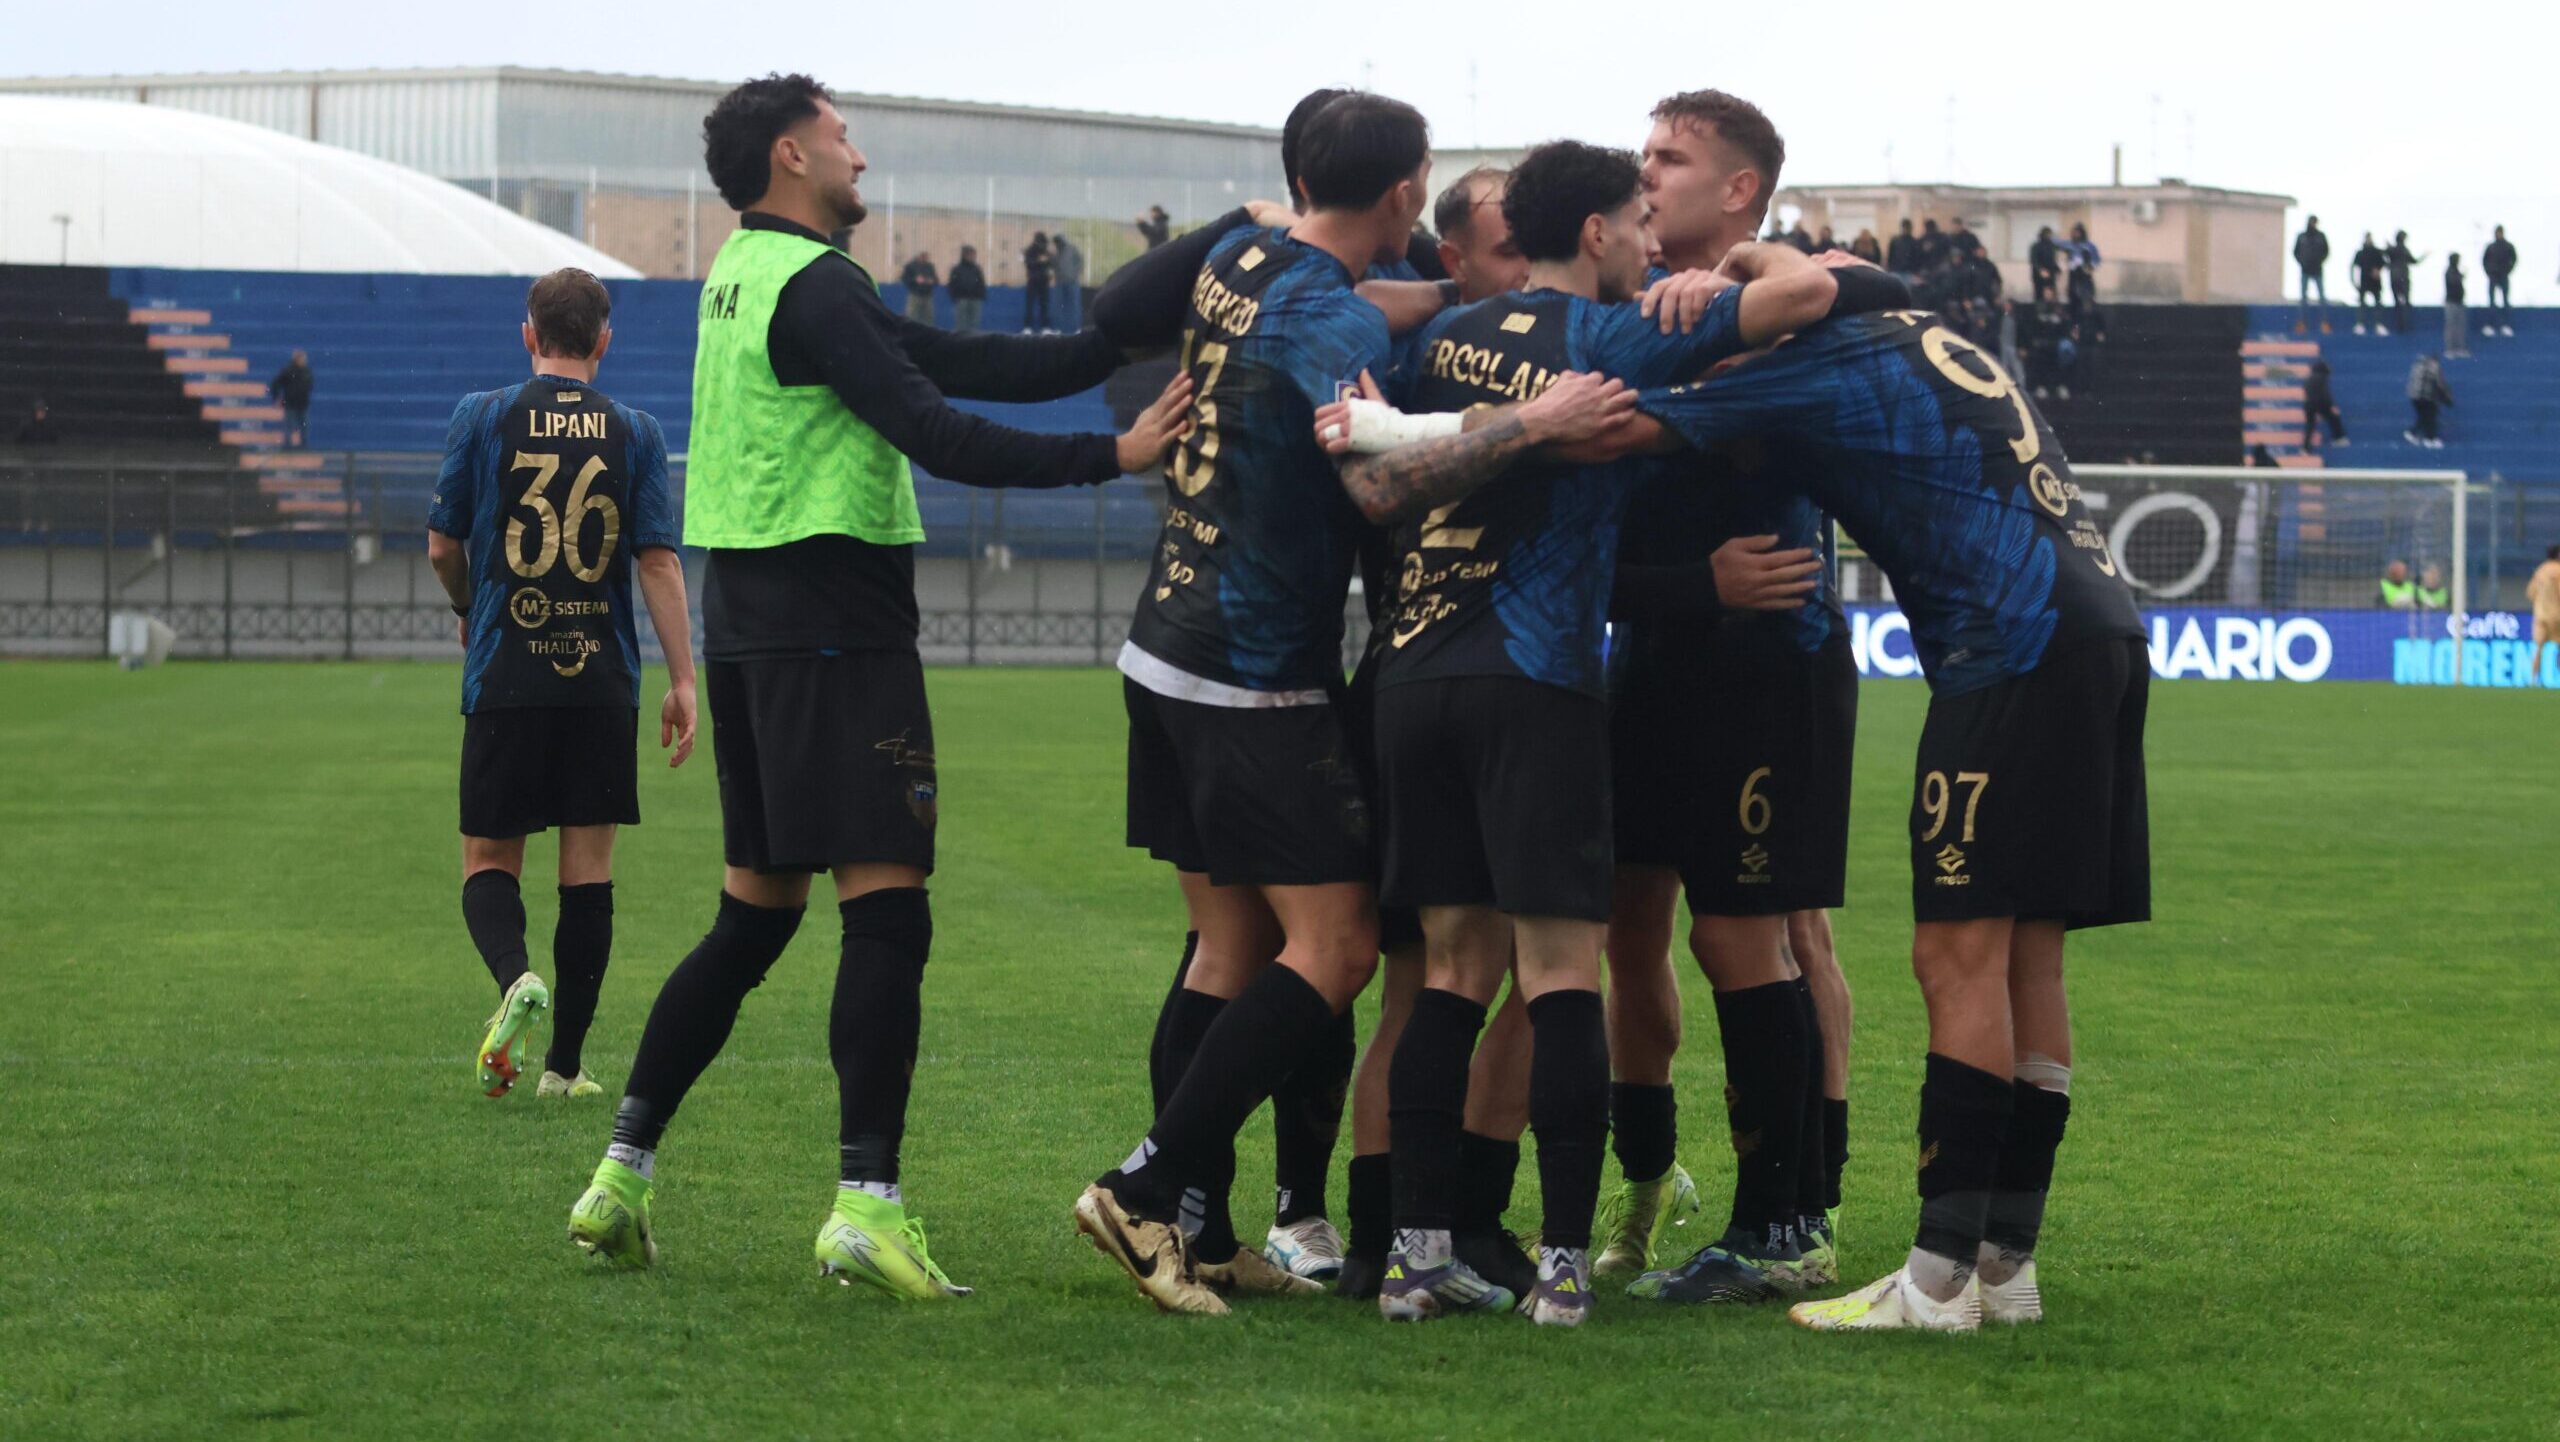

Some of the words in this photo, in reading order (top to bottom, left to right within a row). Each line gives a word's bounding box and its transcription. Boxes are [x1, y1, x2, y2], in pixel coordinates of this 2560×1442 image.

[529, 410, 606, 438] LIPANI
[505, 450, 620, 582] 36
[554, 601, 609, 615] SISTEMI
[528, 640, 600, 654] THAILAND
[1739, 767, 1771, 834] 6
[1922, 770, 1990, 842] 97
